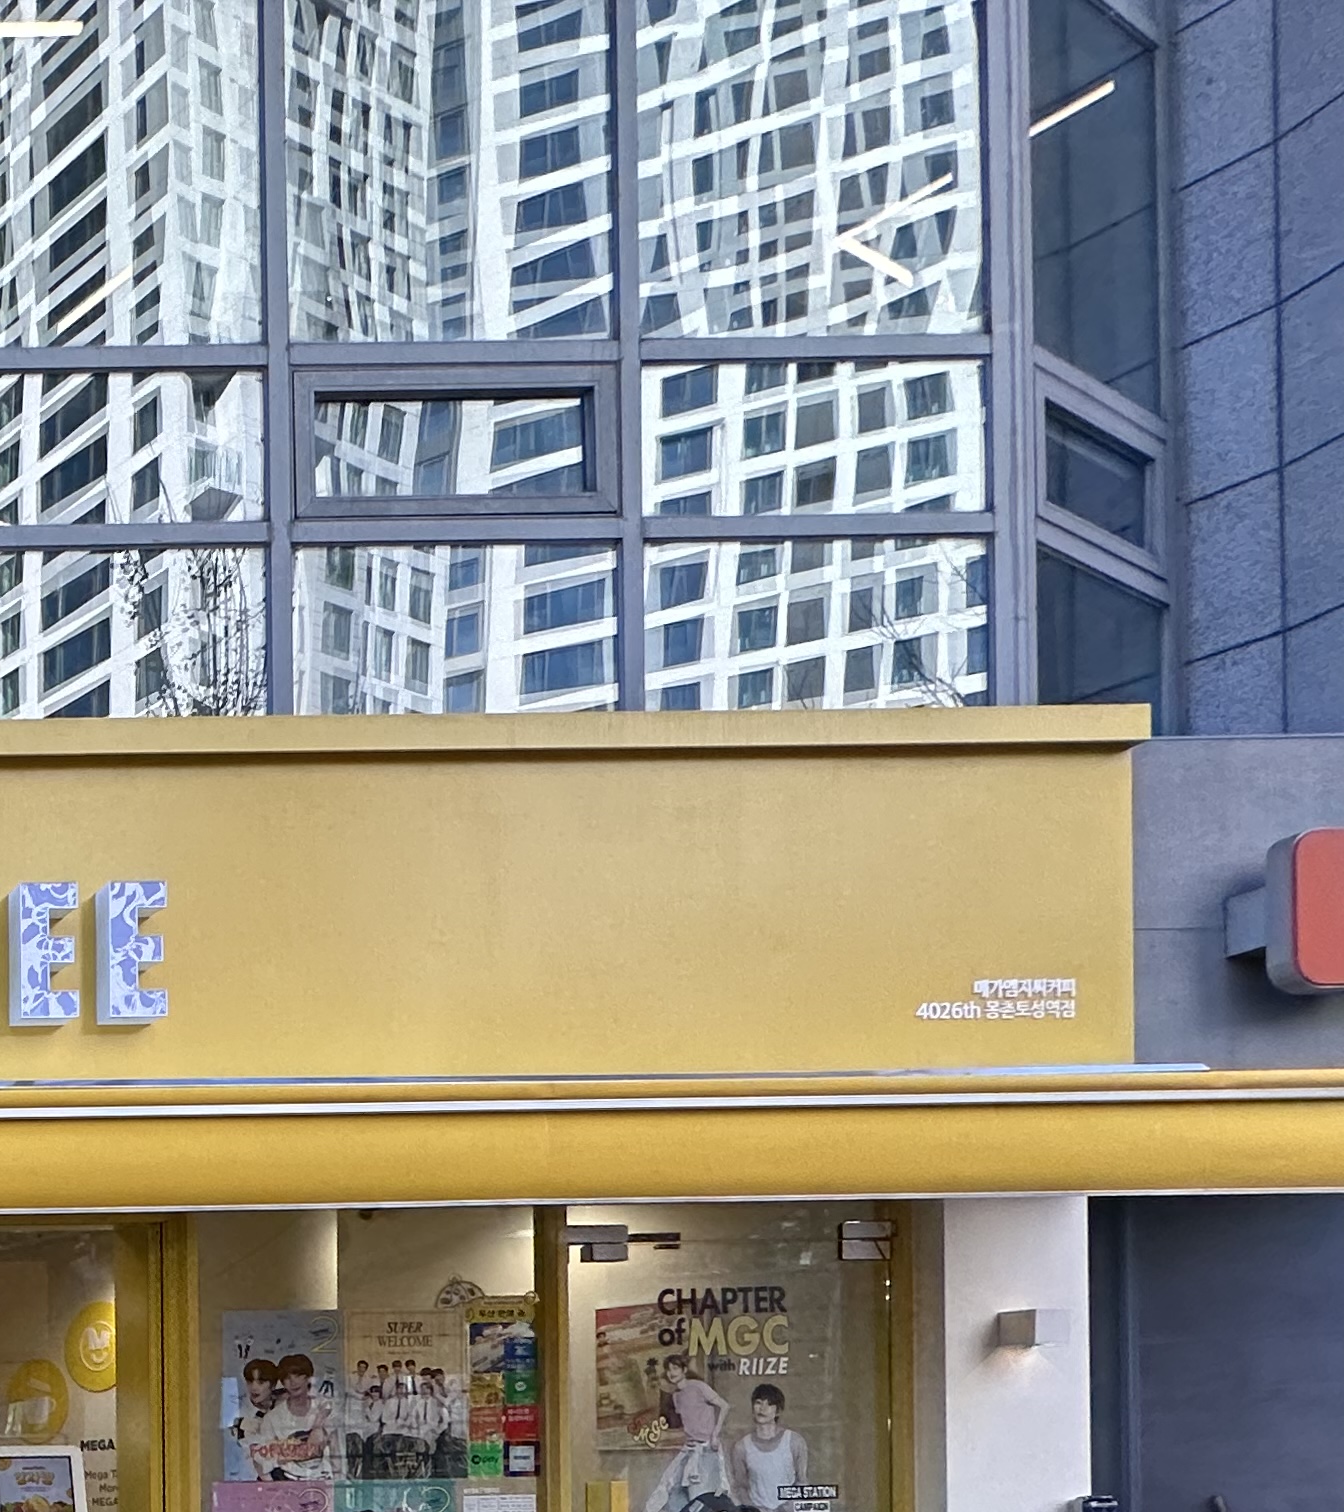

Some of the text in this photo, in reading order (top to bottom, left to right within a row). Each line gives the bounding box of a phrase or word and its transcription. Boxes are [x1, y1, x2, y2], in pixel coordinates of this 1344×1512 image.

[972, 977, 1077, 999] 메가엠지씨커피
[915, 999, 1076, 1020] 4026th 몽촌토성역점
[657, 1286, 787, 1316] CHAPTER
[386, 1321, 423, 1334] SUPER
[657, 1314, 789, 1357] of MGC
[377, 1335, 433, 1348] WELCOME
[708, 1356, 789, 1376] with RIIZE
[80, 1438, 115, 1451] MEGA
[803, 1485, 837, 1498] STATION
